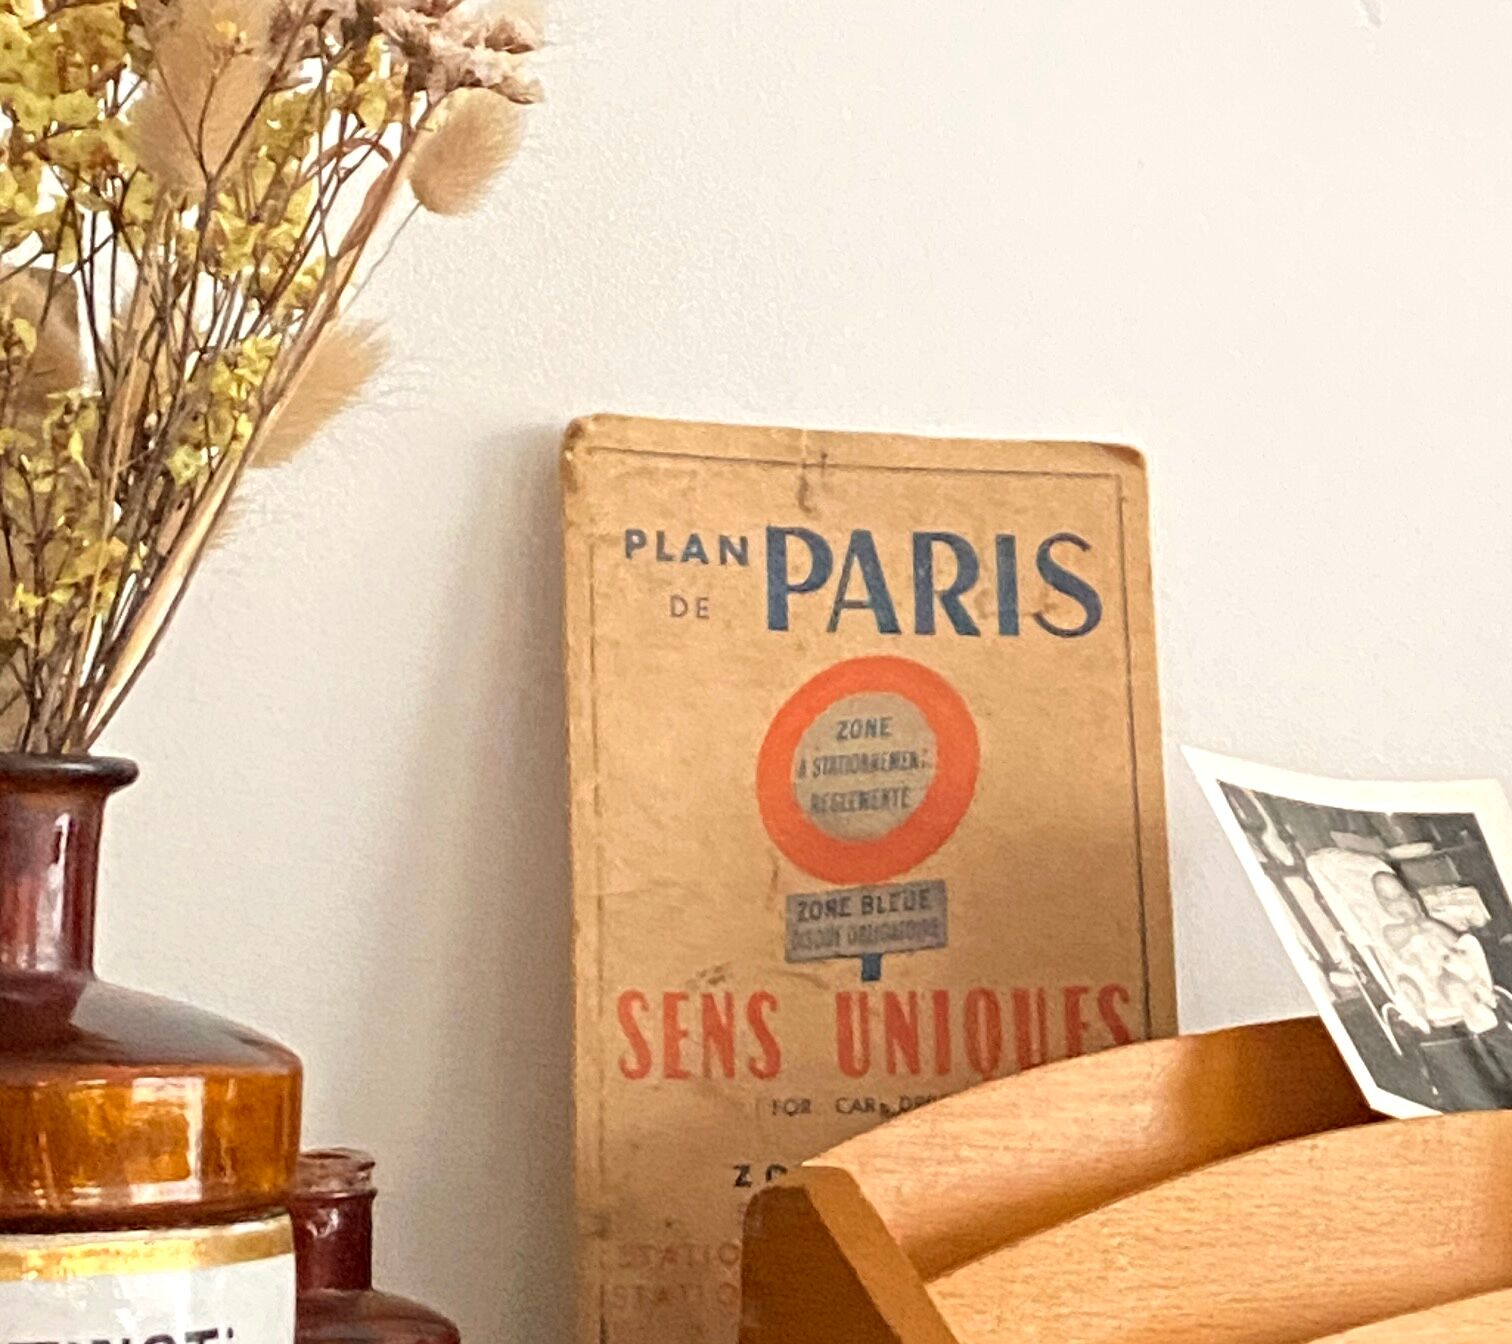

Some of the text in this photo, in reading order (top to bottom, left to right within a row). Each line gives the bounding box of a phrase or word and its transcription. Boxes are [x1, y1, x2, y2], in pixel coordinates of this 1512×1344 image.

[624, 528, 750, 567] PLAN
[765, 524, 1103, 639] PARIS
[669, 595, 710, 620] DE
[835, 716, 894, 742] ZONE
[797, 887, 931, 923] ZONE BLEUE
[616, 983, 1133, 1083] SENS UNIQUES
